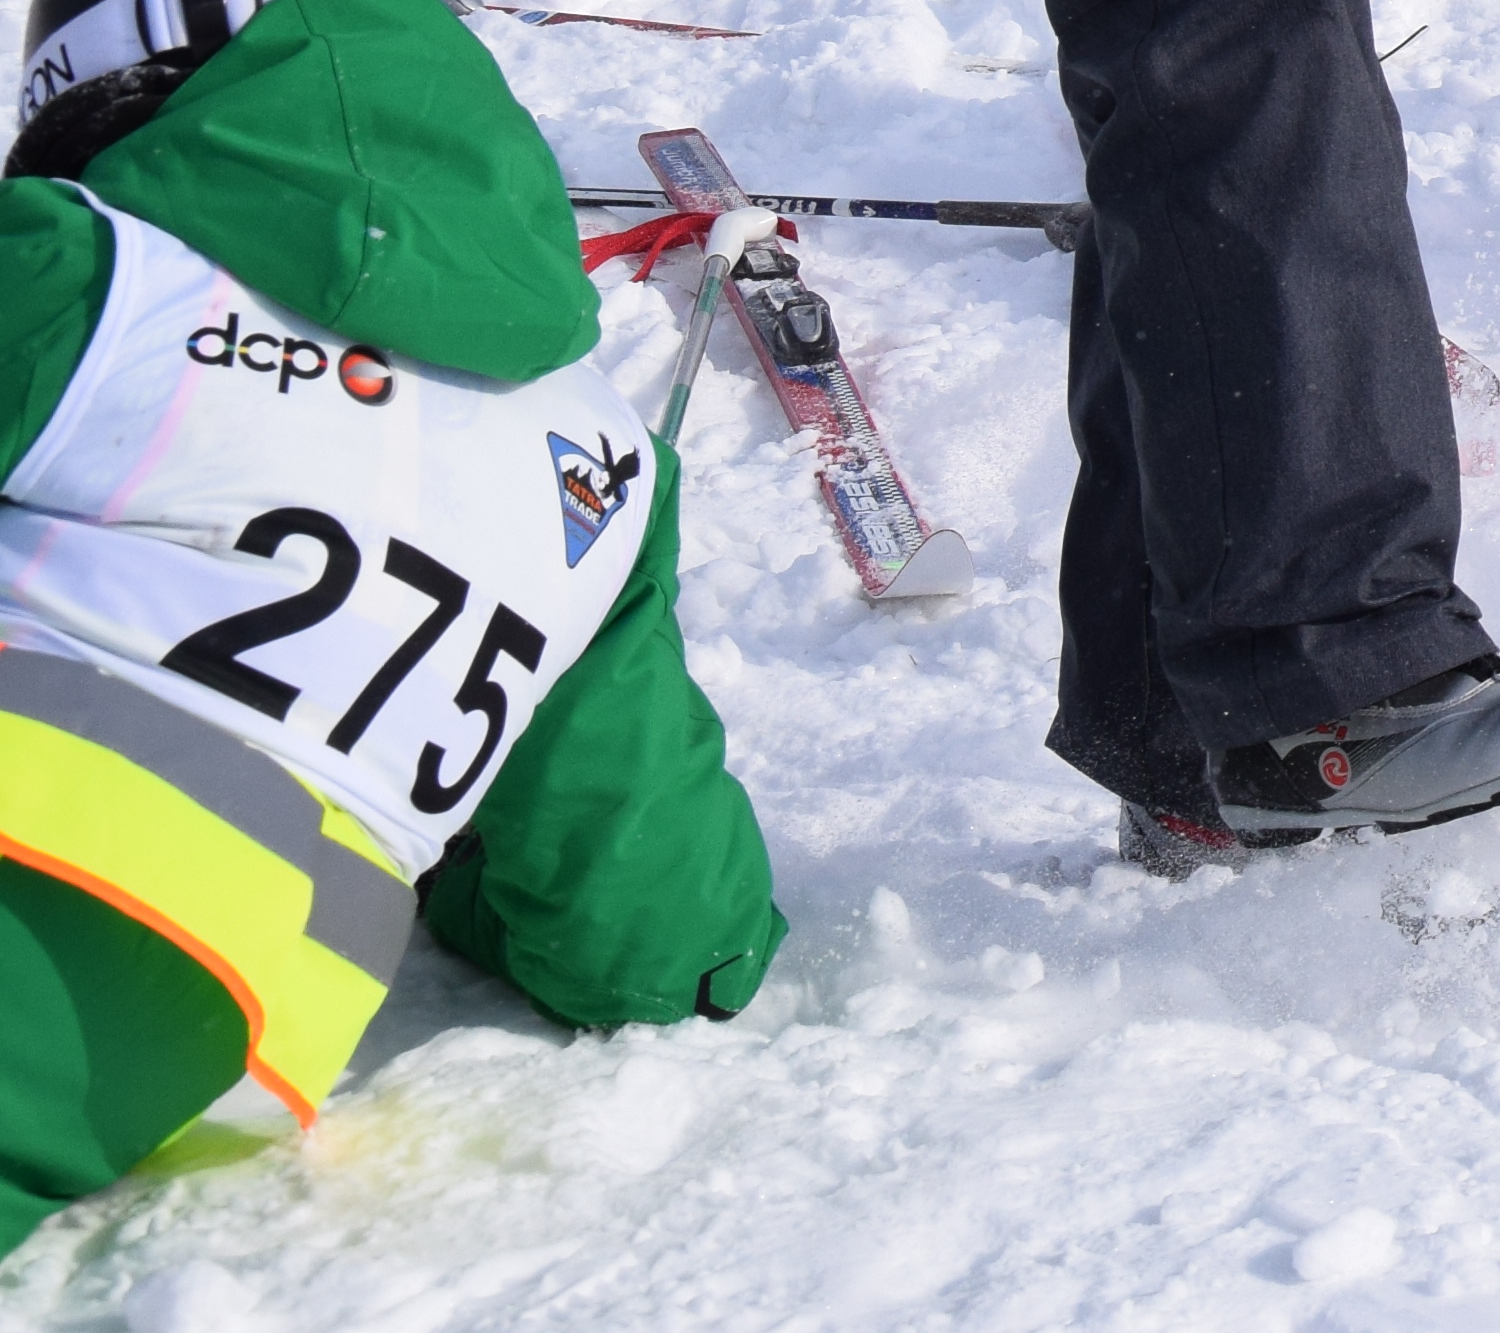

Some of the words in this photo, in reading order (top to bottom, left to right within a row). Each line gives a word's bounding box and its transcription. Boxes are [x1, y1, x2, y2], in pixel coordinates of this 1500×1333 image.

[186, 312, 328, 395] dcp
[564, 490, 601, 527] TRADE
[566, 475, 603, 513] TATRA
[160, 507, 546, 815] 275
